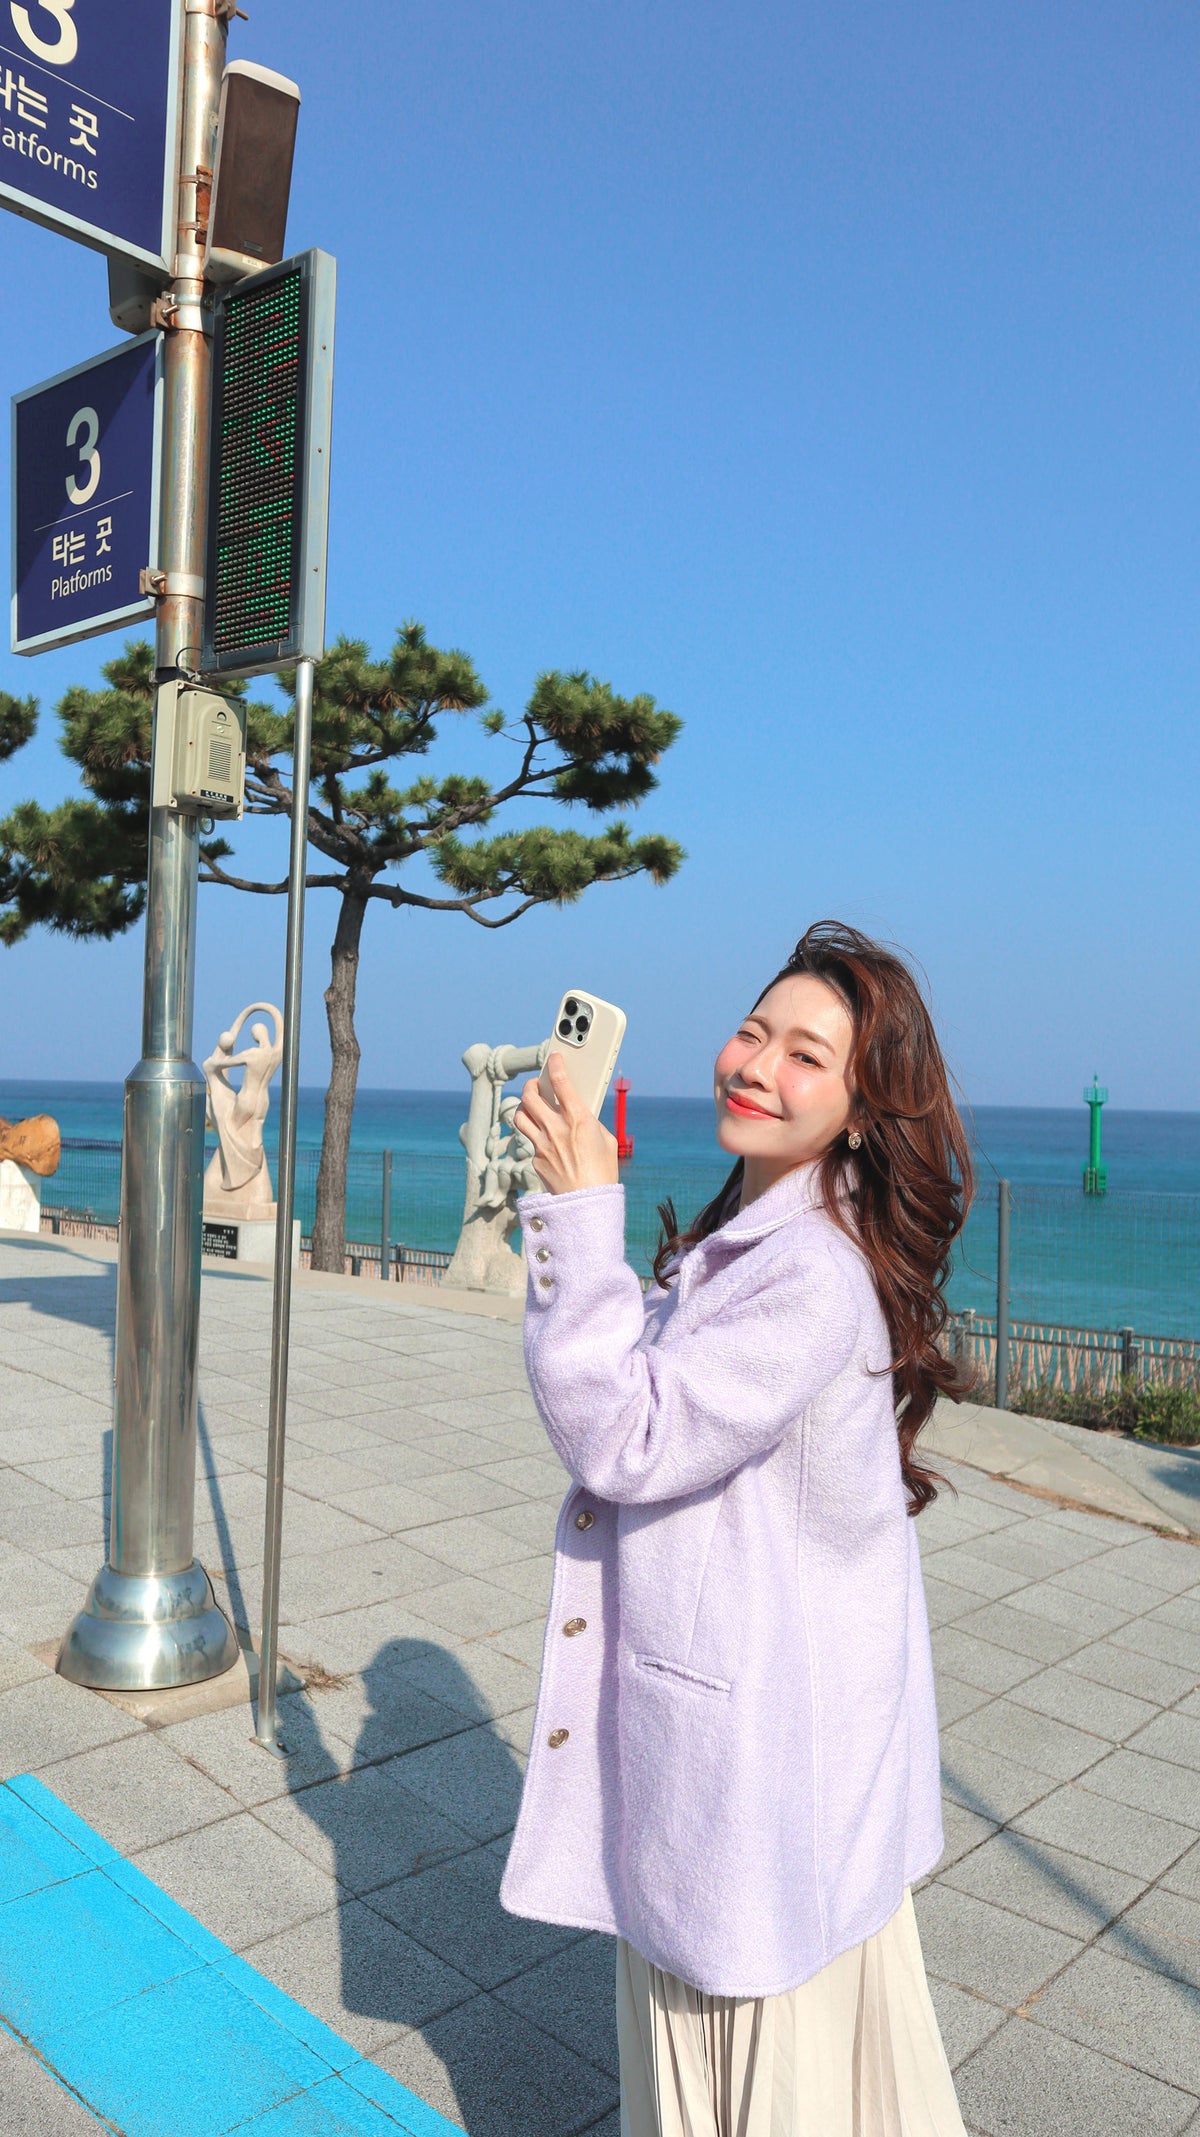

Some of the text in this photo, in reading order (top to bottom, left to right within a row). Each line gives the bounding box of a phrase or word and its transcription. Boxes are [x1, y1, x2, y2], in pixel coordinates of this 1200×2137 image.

[10, 0, 78, 64] 3
[0, 126, 98, 189] atforms
[69, 103, 99, 156] 곳
[65, 406, 101, 505] 3
[52, 516, 113, 567] 타는 곳
[51, 565, 113, 600] Platforms
